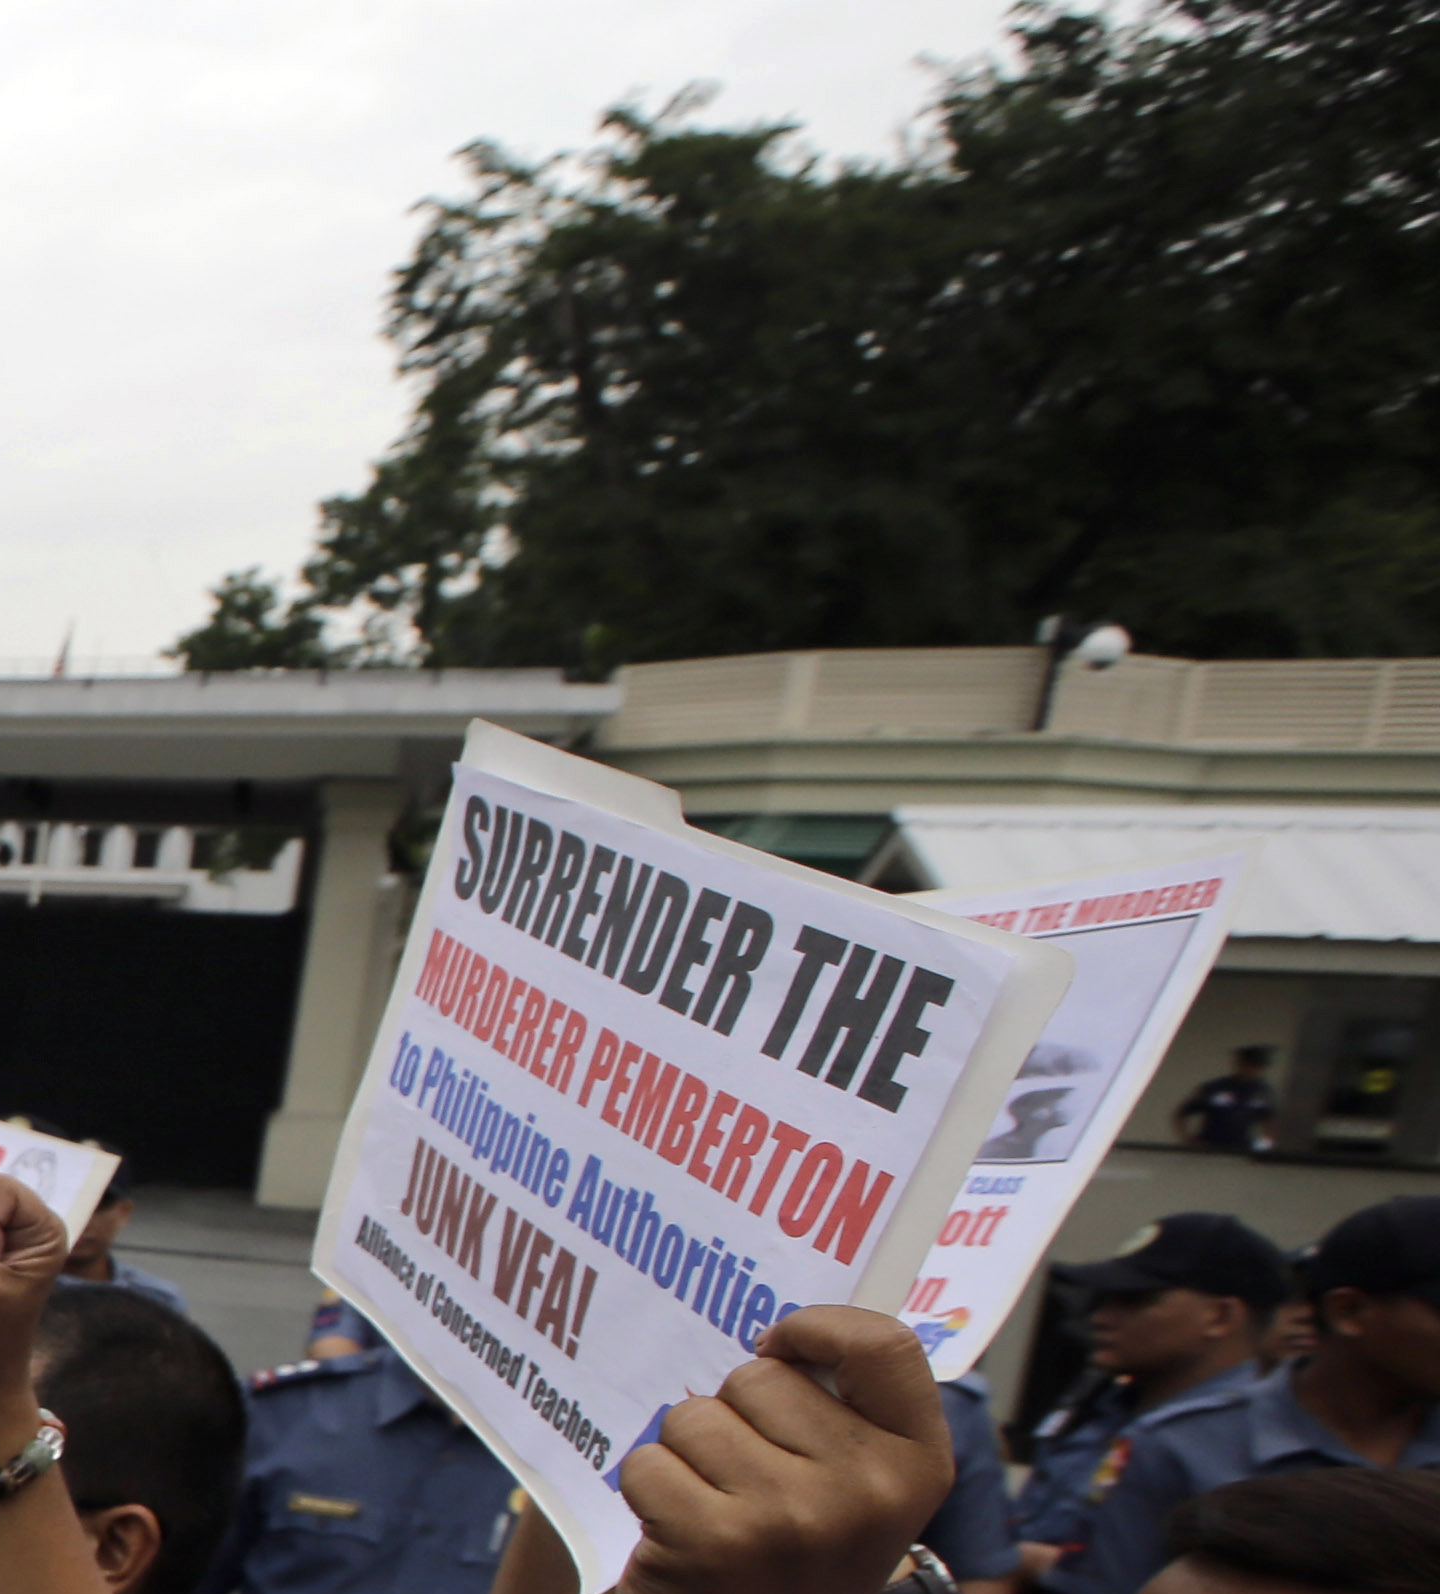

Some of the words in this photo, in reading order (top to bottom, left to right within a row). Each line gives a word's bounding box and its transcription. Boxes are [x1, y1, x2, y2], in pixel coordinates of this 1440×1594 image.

[455, 795, 775, 1037] SURRENDER
[760, 925, 955, 1113] THE
[1022, 902, 1072, 934] THE
[1069, 877, 1224, 926] MURDERER
[390, 1031, 423, 1098] to
[418, 1047, 569, 1207] Philippine
[415, 928, 587, 1095] MURDERER
[577, 1027, 895, 1266] PEMBERTON
[401, 1136, 498, 1281] JUNK
[493, 1206, 598, 1361] VFA!
[936, 1205, 1009, 1246] ott
[354, 1215, 416, 1291] Alliance
[415, 1271, 436, 1307] of
[431, 1282, 525, 1389] Concerned
[521, 1361, 611, 1471] Teachers
